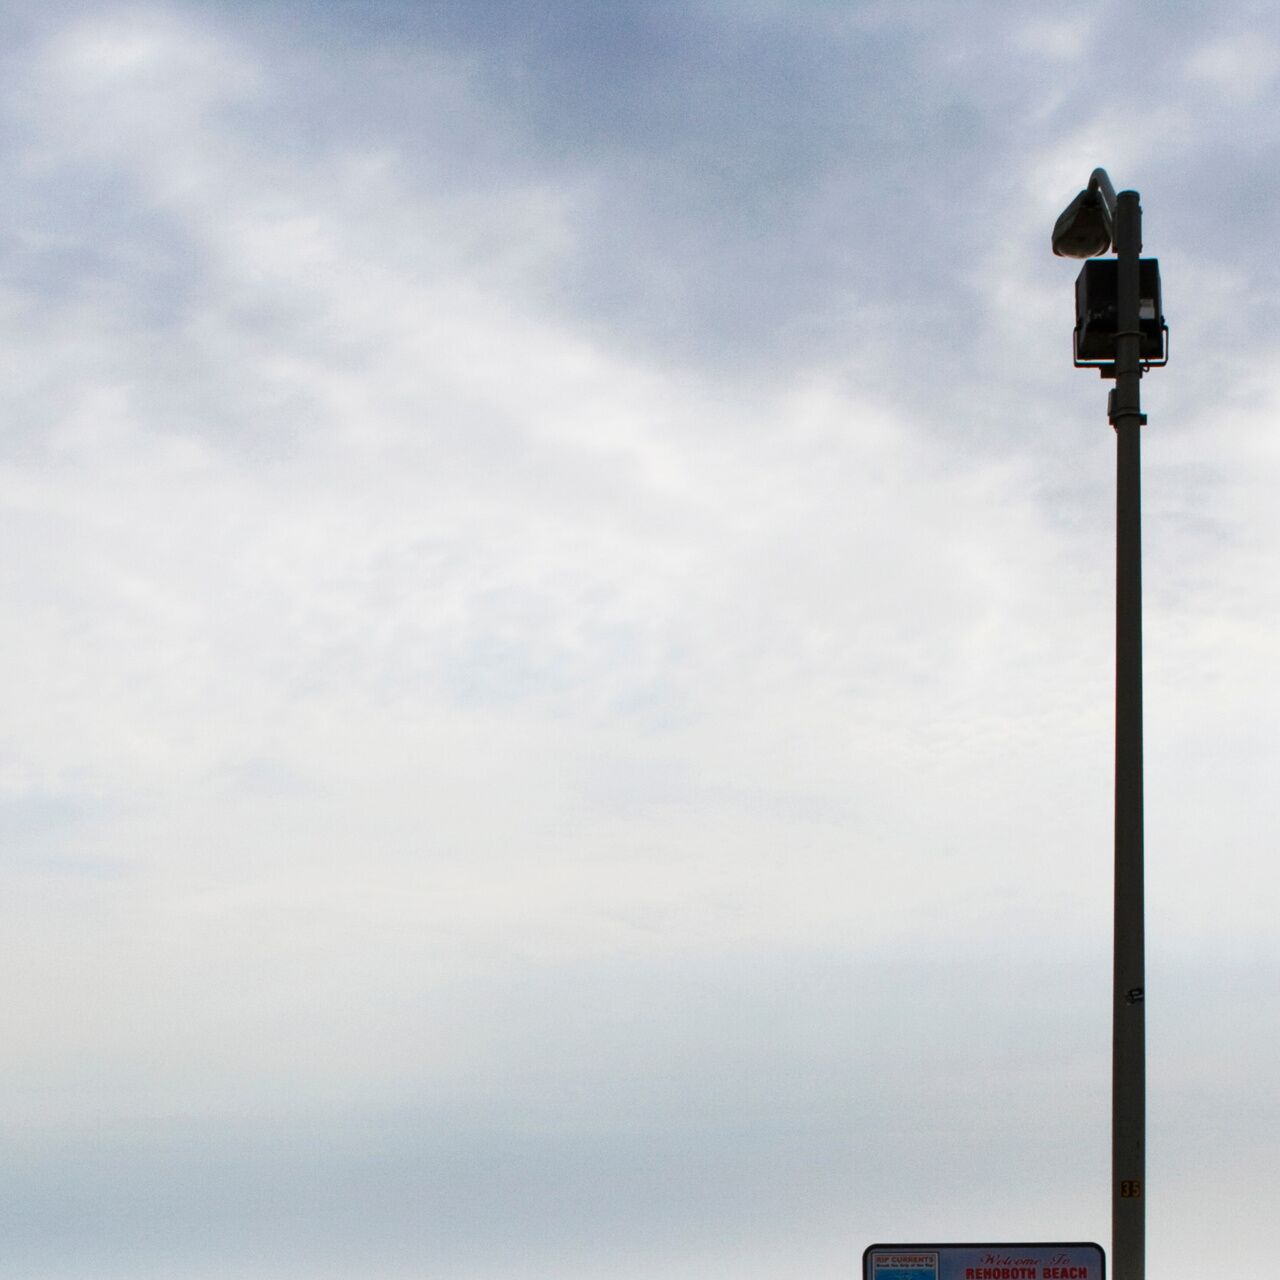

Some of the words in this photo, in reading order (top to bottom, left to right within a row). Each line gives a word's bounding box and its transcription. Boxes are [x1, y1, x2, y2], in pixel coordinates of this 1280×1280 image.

[981, 1254, 1040, 1265] Welcome
[1050, 1253, 1072, 1265] To
[965, 1267, 1036, 1280] REHOBOTH
[1042, 1267, 1088, 1279] BEACH
